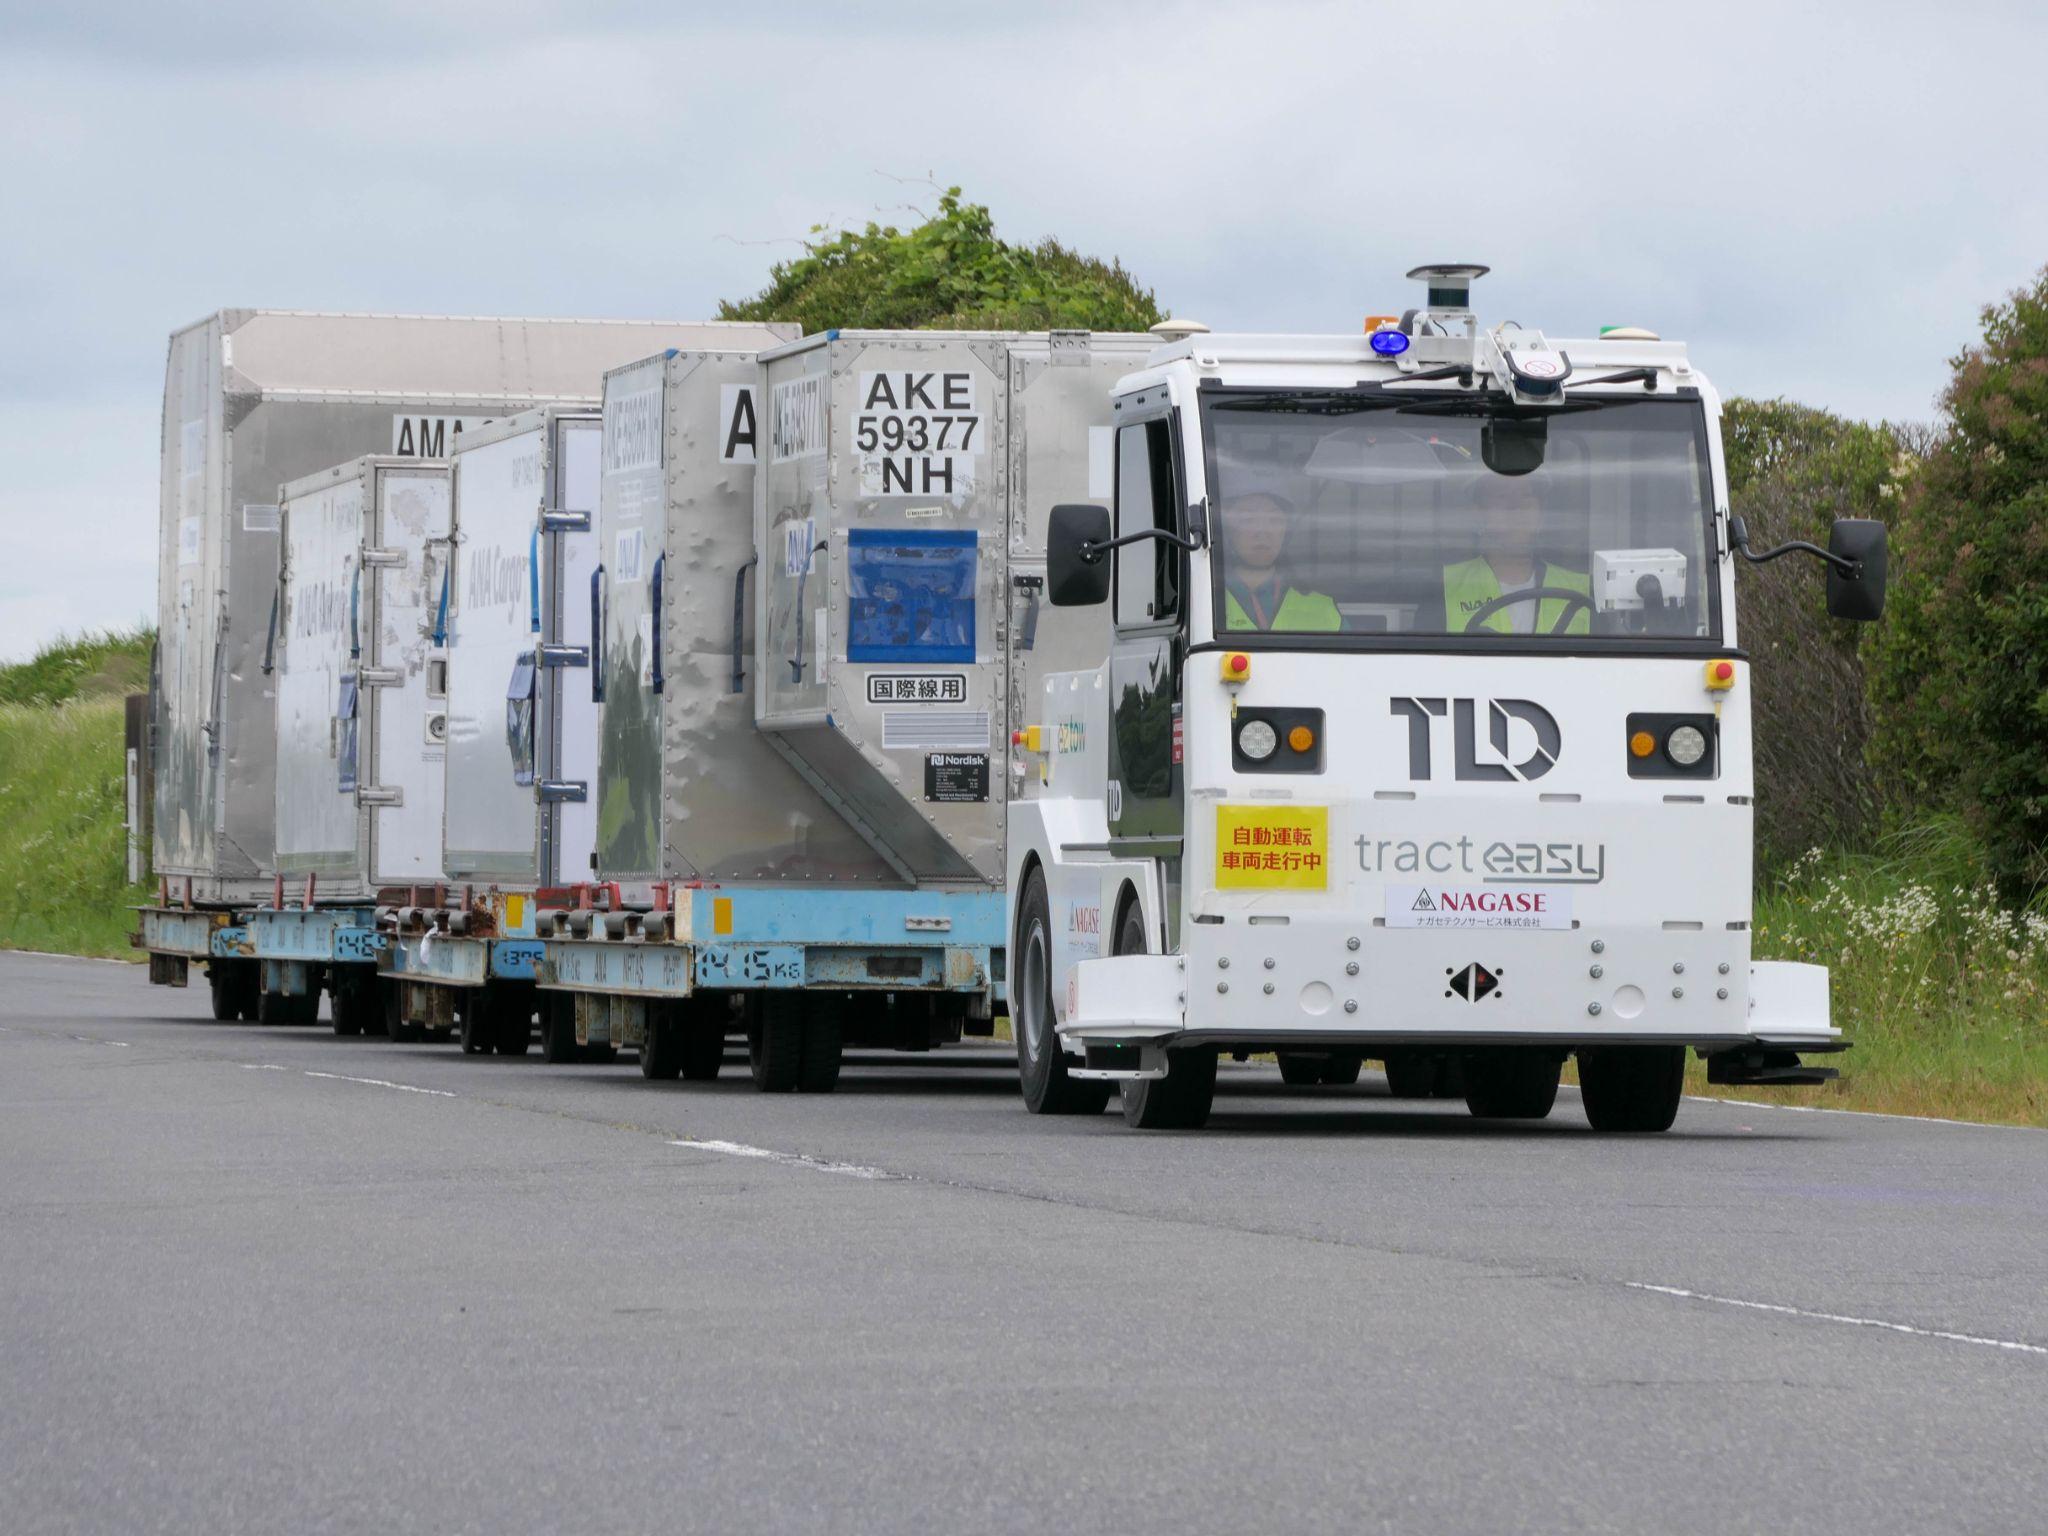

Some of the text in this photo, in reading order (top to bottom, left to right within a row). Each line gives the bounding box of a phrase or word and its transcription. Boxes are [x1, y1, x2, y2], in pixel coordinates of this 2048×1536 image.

[865, 373, 971, 410] AKE
[857, 415, 979, 451] 59377
[882, 457, 953, 493] NH
[467, 545, 523, 625] ANA Cargo
[874, 679, 959, 699] 国際線用
[1390, 697, 1561, 781] TLD
[945, 755, 984, 766] Nordisk
[1233, 827, 1312, 847] 自動運転
[1222, 852, 1321, 871] 車両走行中
[1441, 892, 1547, 913] NAGASE
[1076, 908, 1100, 934] NAGASE
[1416, 916, 1541, 928] ナガセテクノサービス株式会社
